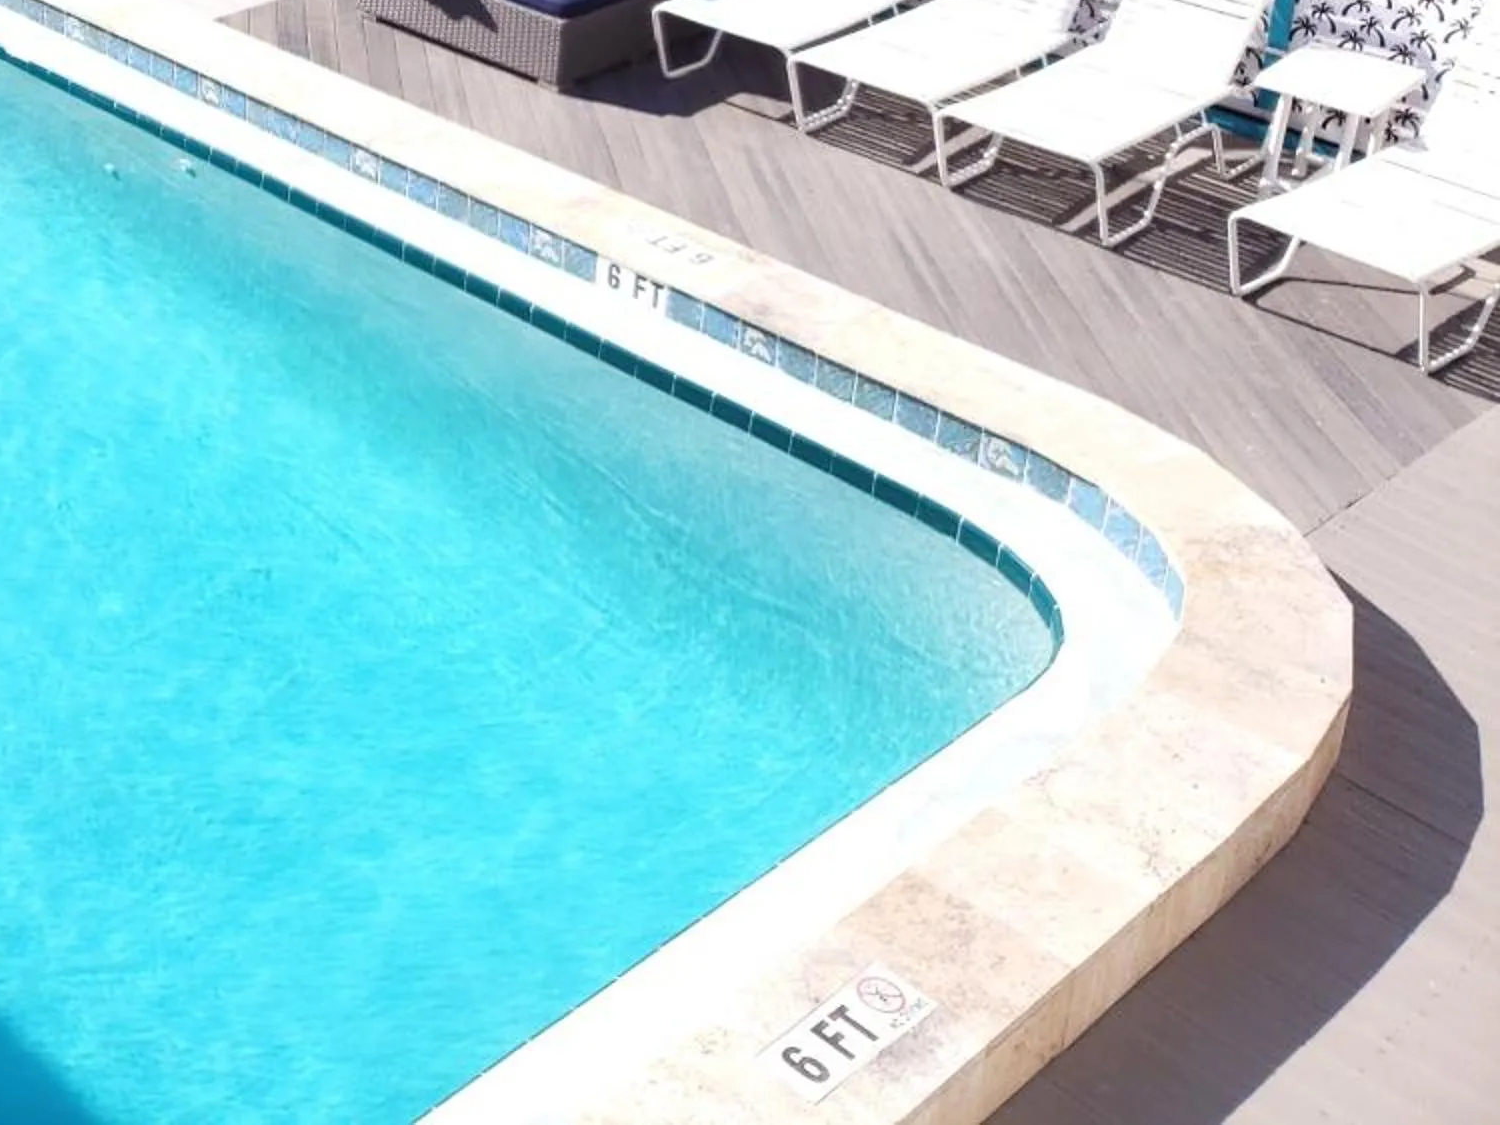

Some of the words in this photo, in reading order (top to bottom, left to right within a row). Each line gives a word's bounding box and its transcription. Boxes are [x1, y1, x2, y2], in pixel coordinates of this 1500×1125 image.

[648, 236, 687, 253] FT
[607, 263, 621, 290] 6
[632, 272, 665, 309] FT
[781, 1046, 831, 1084] 6
[810, 1004, 880, 1061] FT
